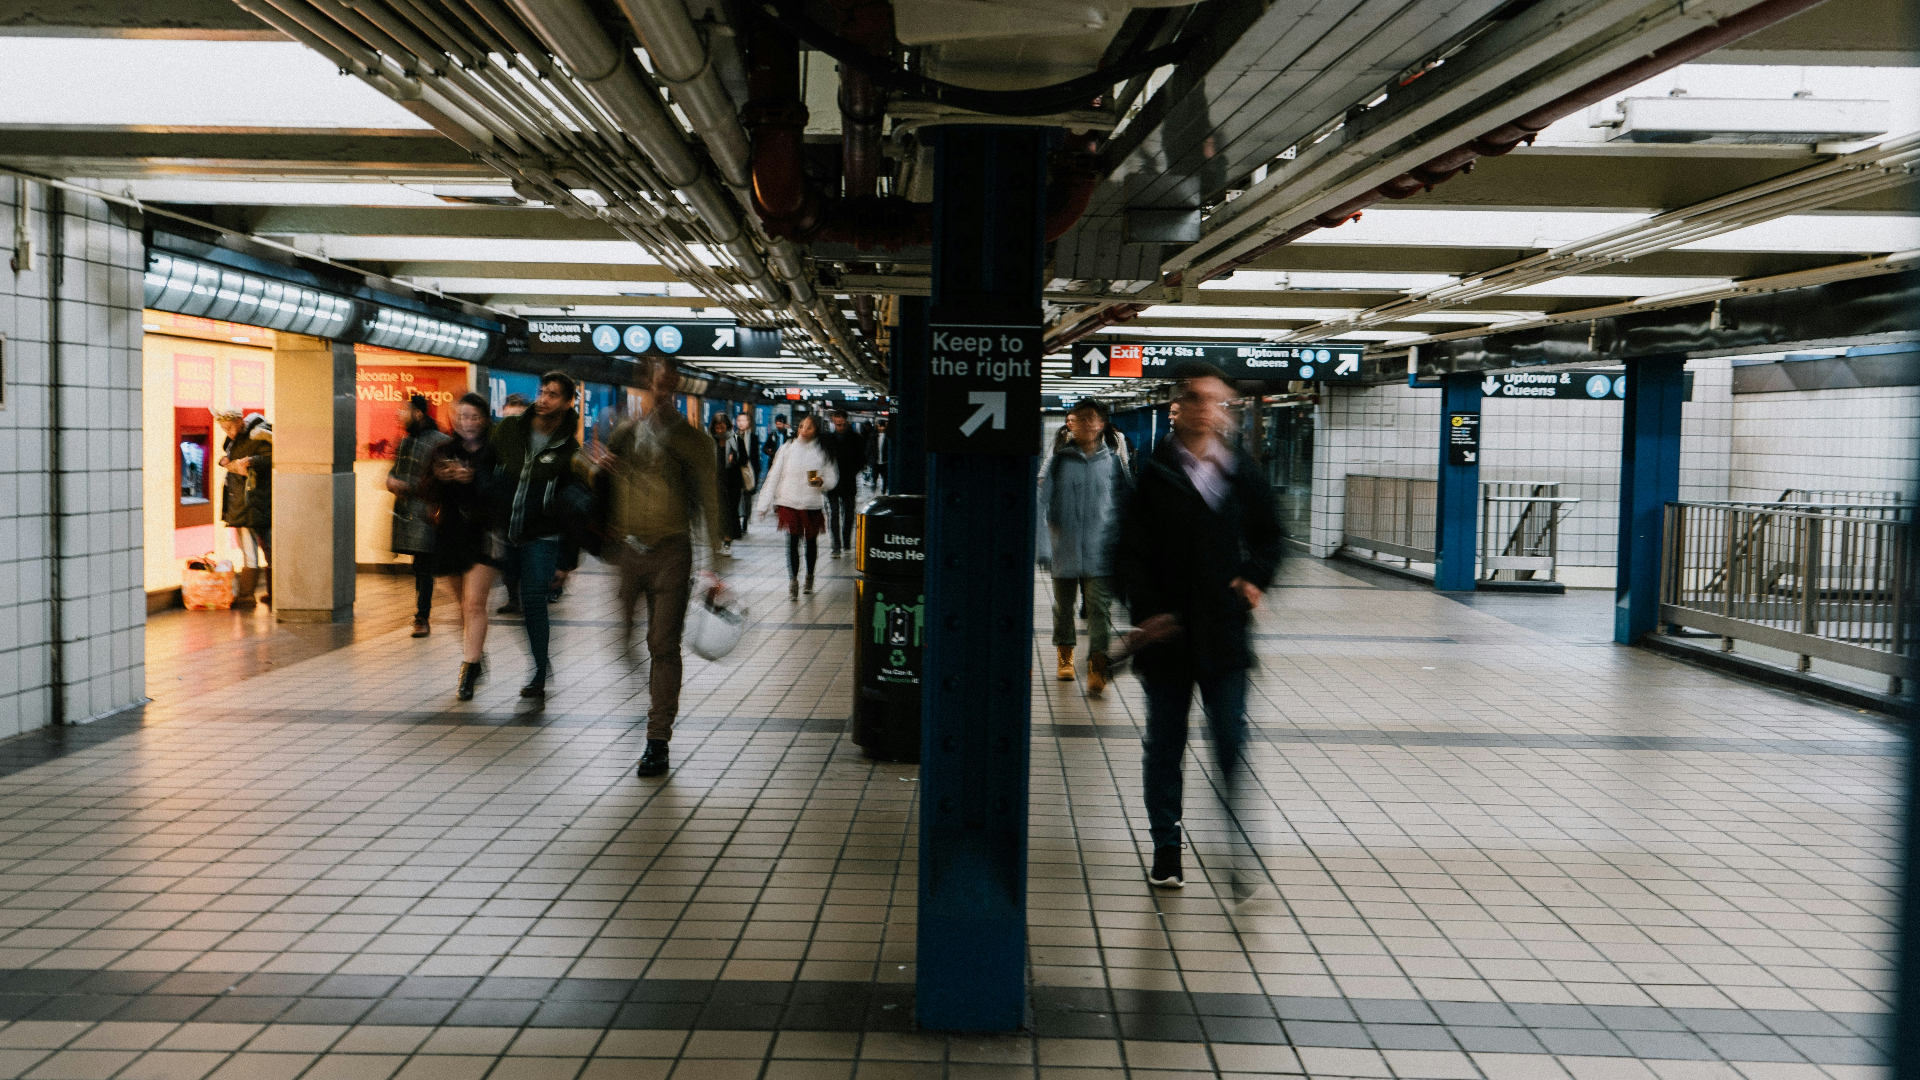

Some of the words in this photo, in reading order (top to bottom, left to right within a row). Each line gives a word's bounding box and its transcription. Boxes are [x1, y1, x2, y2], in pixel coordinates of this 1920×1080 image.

[539, 323, 580, 333] Uptown
[582, 323, 591, 333] &
[539, 333, 581, 343] Queens
[599, 331, 614, 347] A
[629, 331, 645, 347] C
[661, 331, 675, 347] E
[933, 331, 992, 356] Keep
[1000, 334, 1023, 352] to
[1111, 345, 1140, 359] Exit
[1141, 347, 1173, 356] 43-44
[1174, 347, 1194, 357] Sts
[1195, 347, 1205, 357] &
[1246, 348, 1289, 359] Uptown
[1291, 349, 1300, 358] &
[1141, 357, 1150, 366] 8
[1151, 357, 1167, 366] Av
[1246, 358, 1289, 368] Queens
[356, 368, 399, 382] elcome
[400, 371, 414, 382] to
[931, 356, 968, 375] the
[976, 357, 1031, 382] right
[1503, 373, 1557, 385] Uptown
[1559, 372, 1571, 384] &
[1503, 384, 1556, 396] Queens
[1591, 379, 1604, 393] A
[356, 384, 403, 402] Wells
[884, 533, 922, 546] Litter
[869, 547, 903, 562] Stops
[905, 549, 926, 561] He
